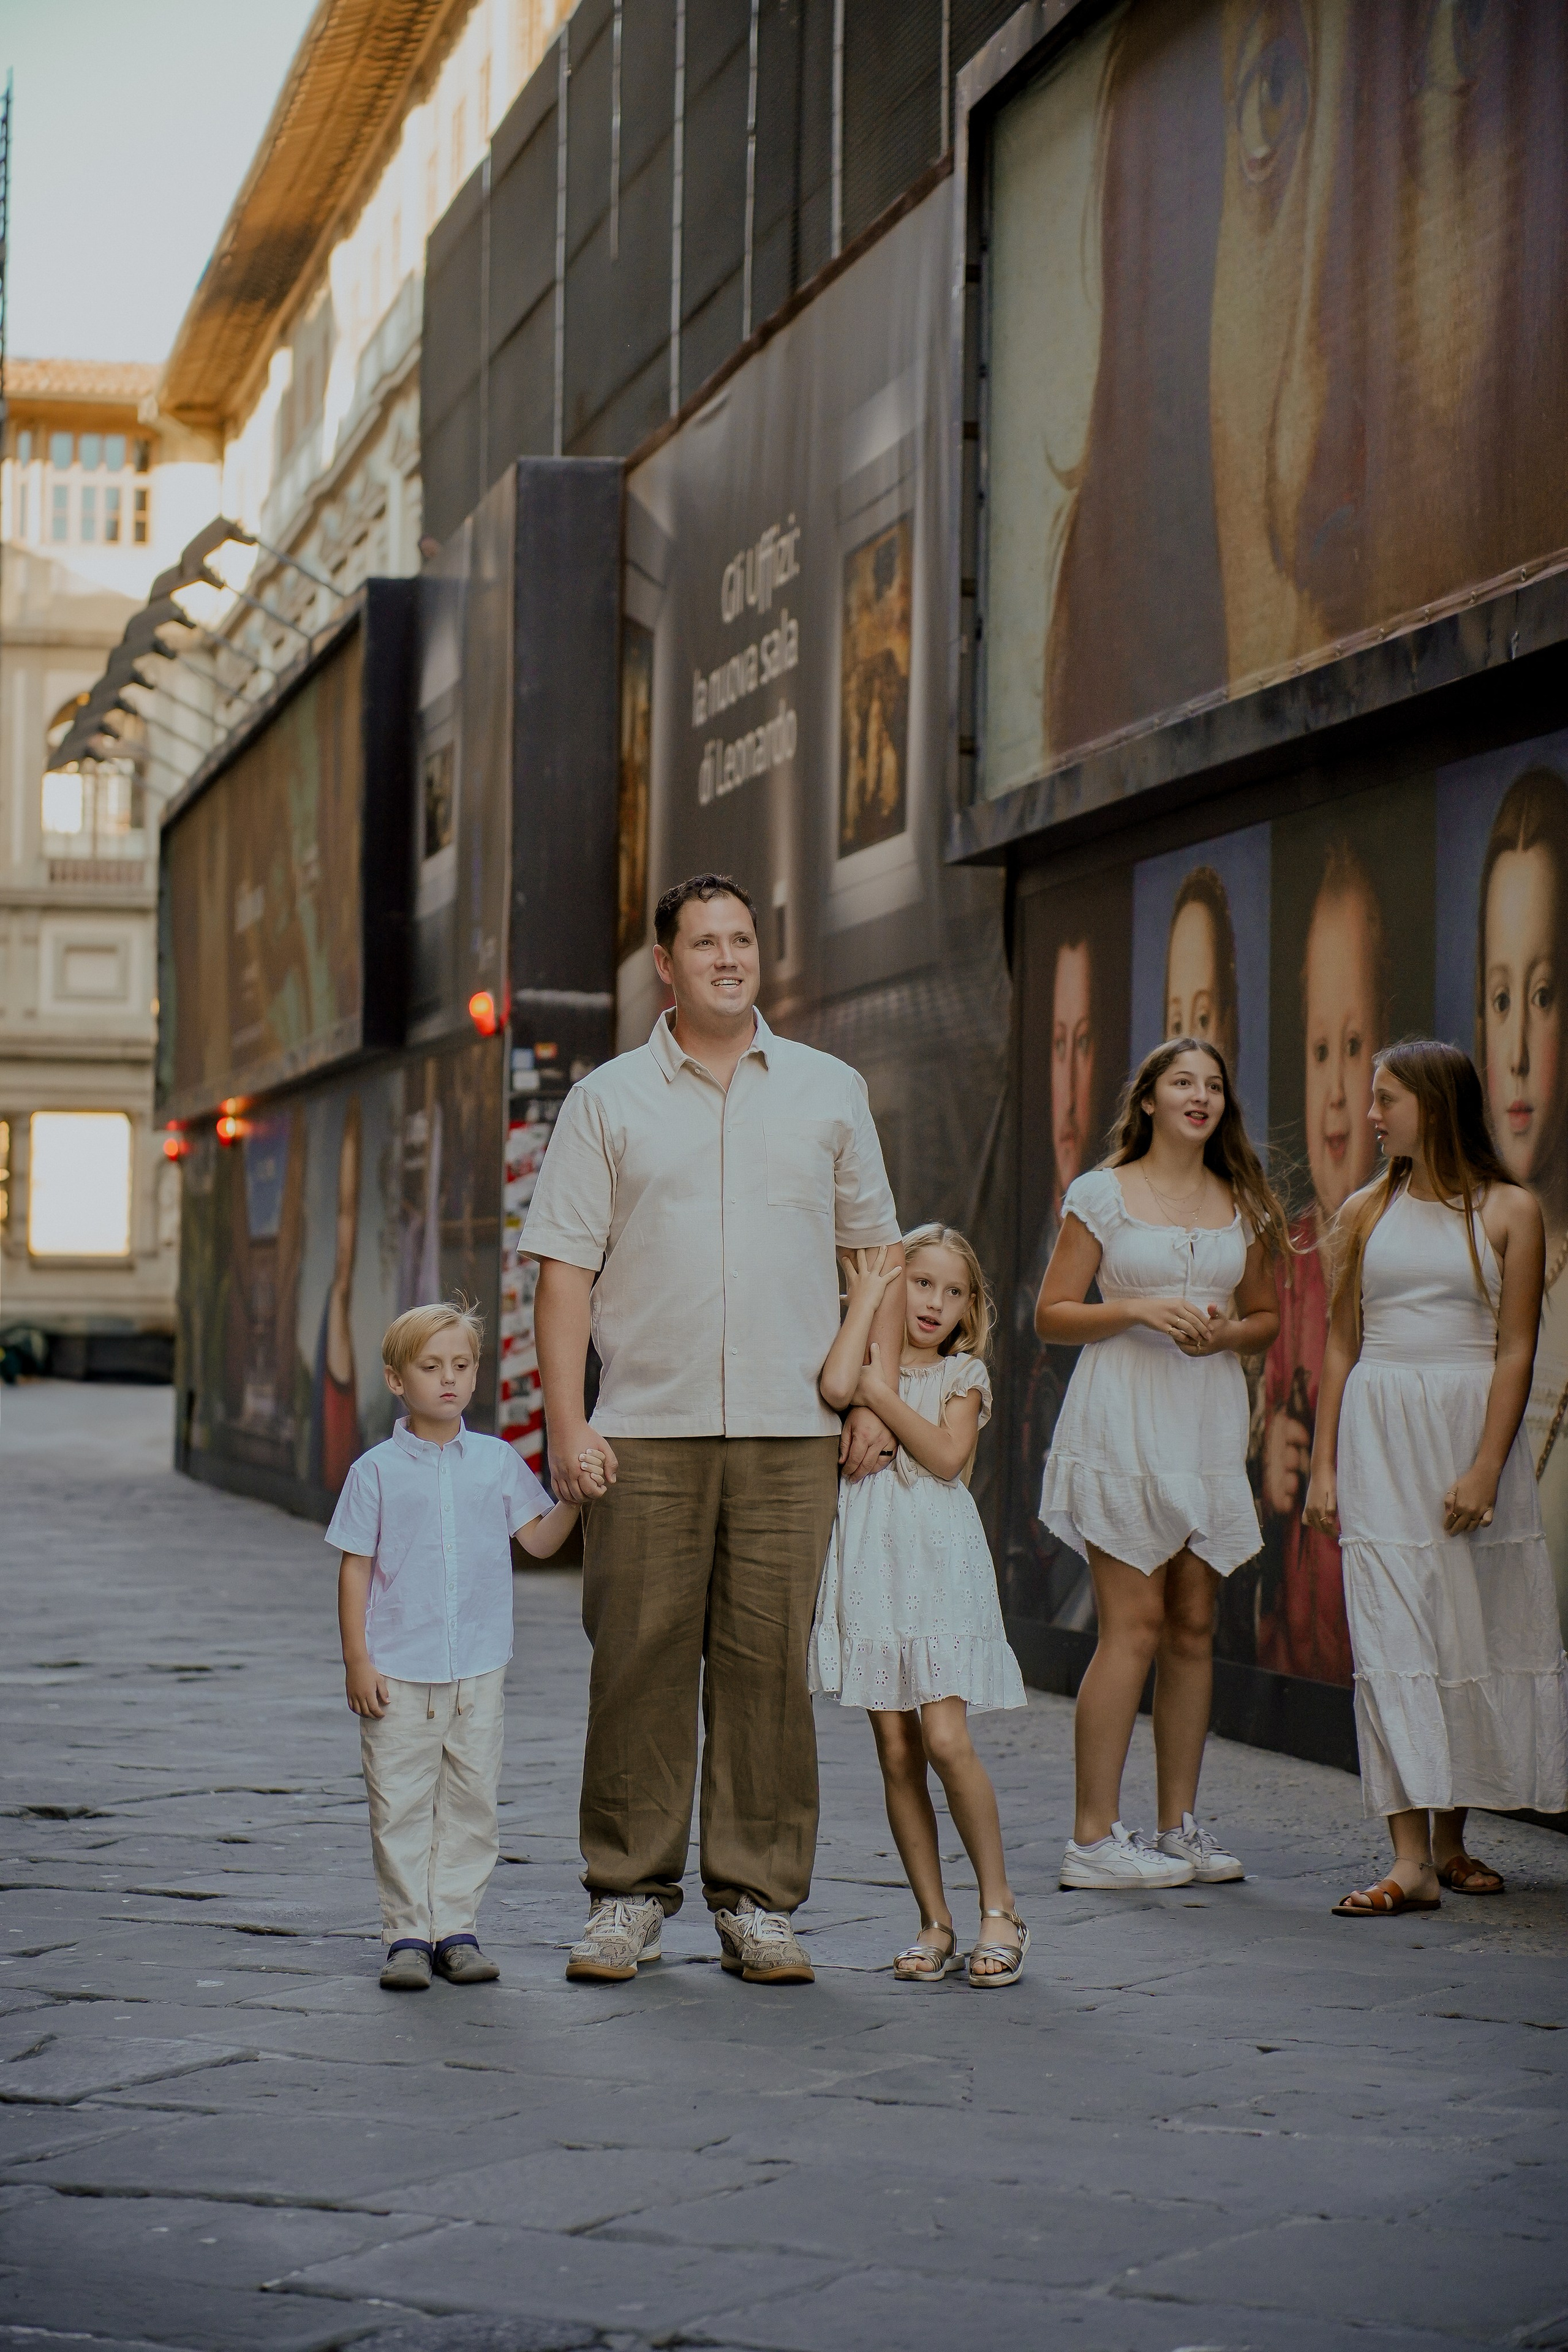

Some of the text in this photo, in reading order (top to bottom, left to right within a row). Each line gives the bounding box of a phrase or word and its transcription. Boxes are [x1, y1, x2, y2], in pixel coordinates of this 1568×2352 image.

[692, 607, 799, 729] la nuova sala
[698, 697, 797, 805] di Leonardo
